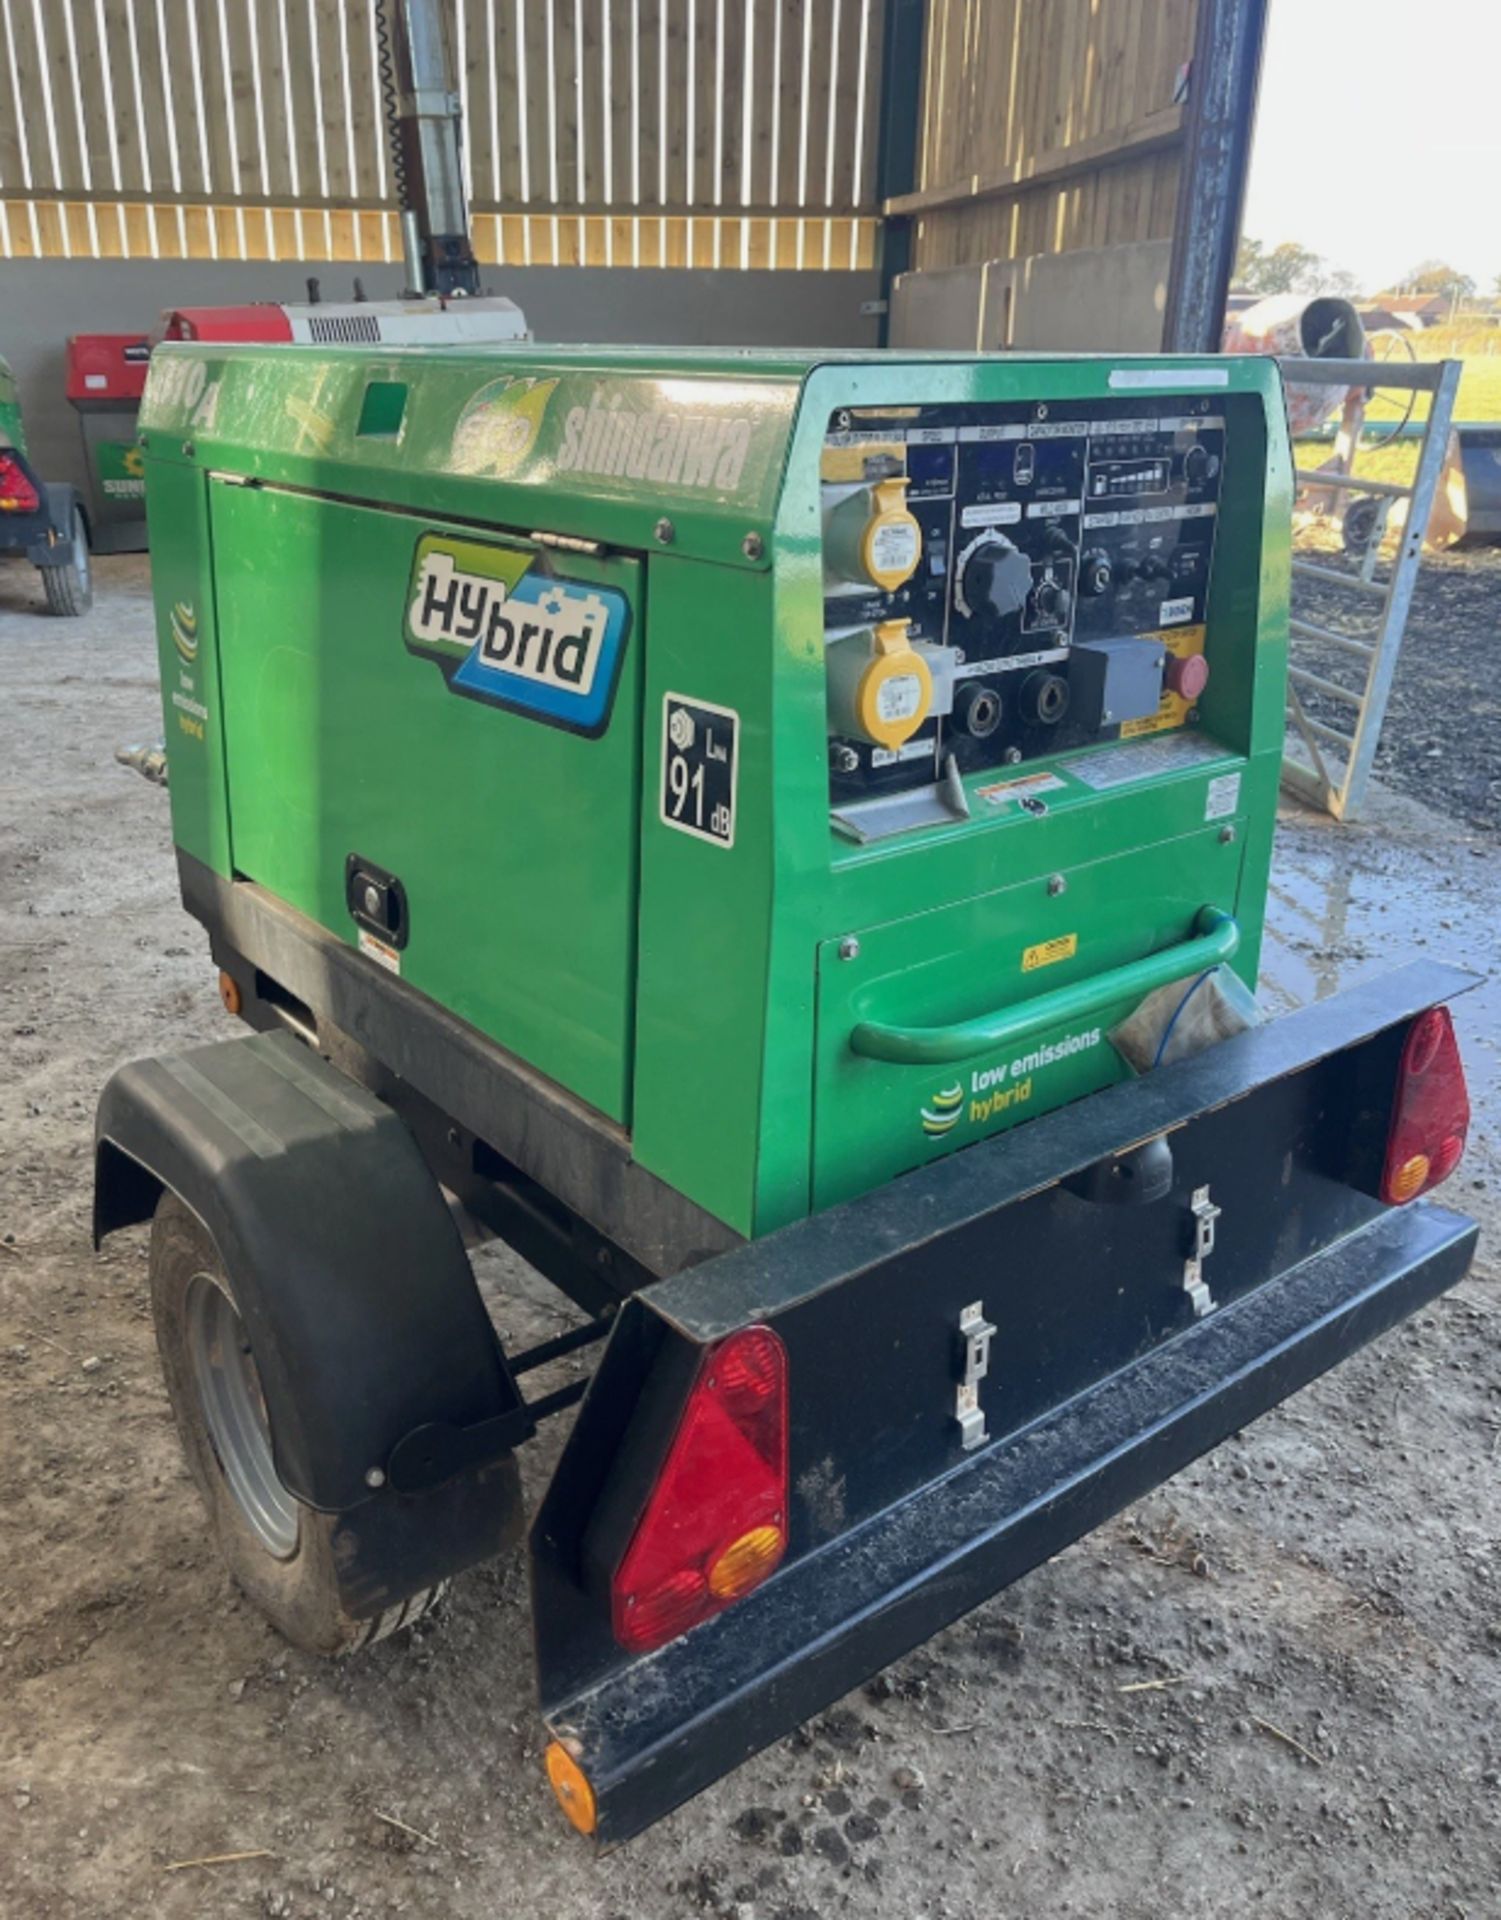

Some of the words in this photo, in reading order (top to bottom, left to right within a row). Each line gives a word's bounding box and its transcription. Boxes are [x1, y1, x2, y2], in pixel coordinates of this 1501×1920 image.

[556, 390, 752, 490] shindaiwa
[421, 574, 593, 685] Hybrid
[669, 755, 705, 827] 91
[710, 802, 731, 836] dB
[971, 1064, 1007, 1093] low
[1010, 1028, 1101, 1078] emissions
[969, 1077, 1032, 1122] hybrid
